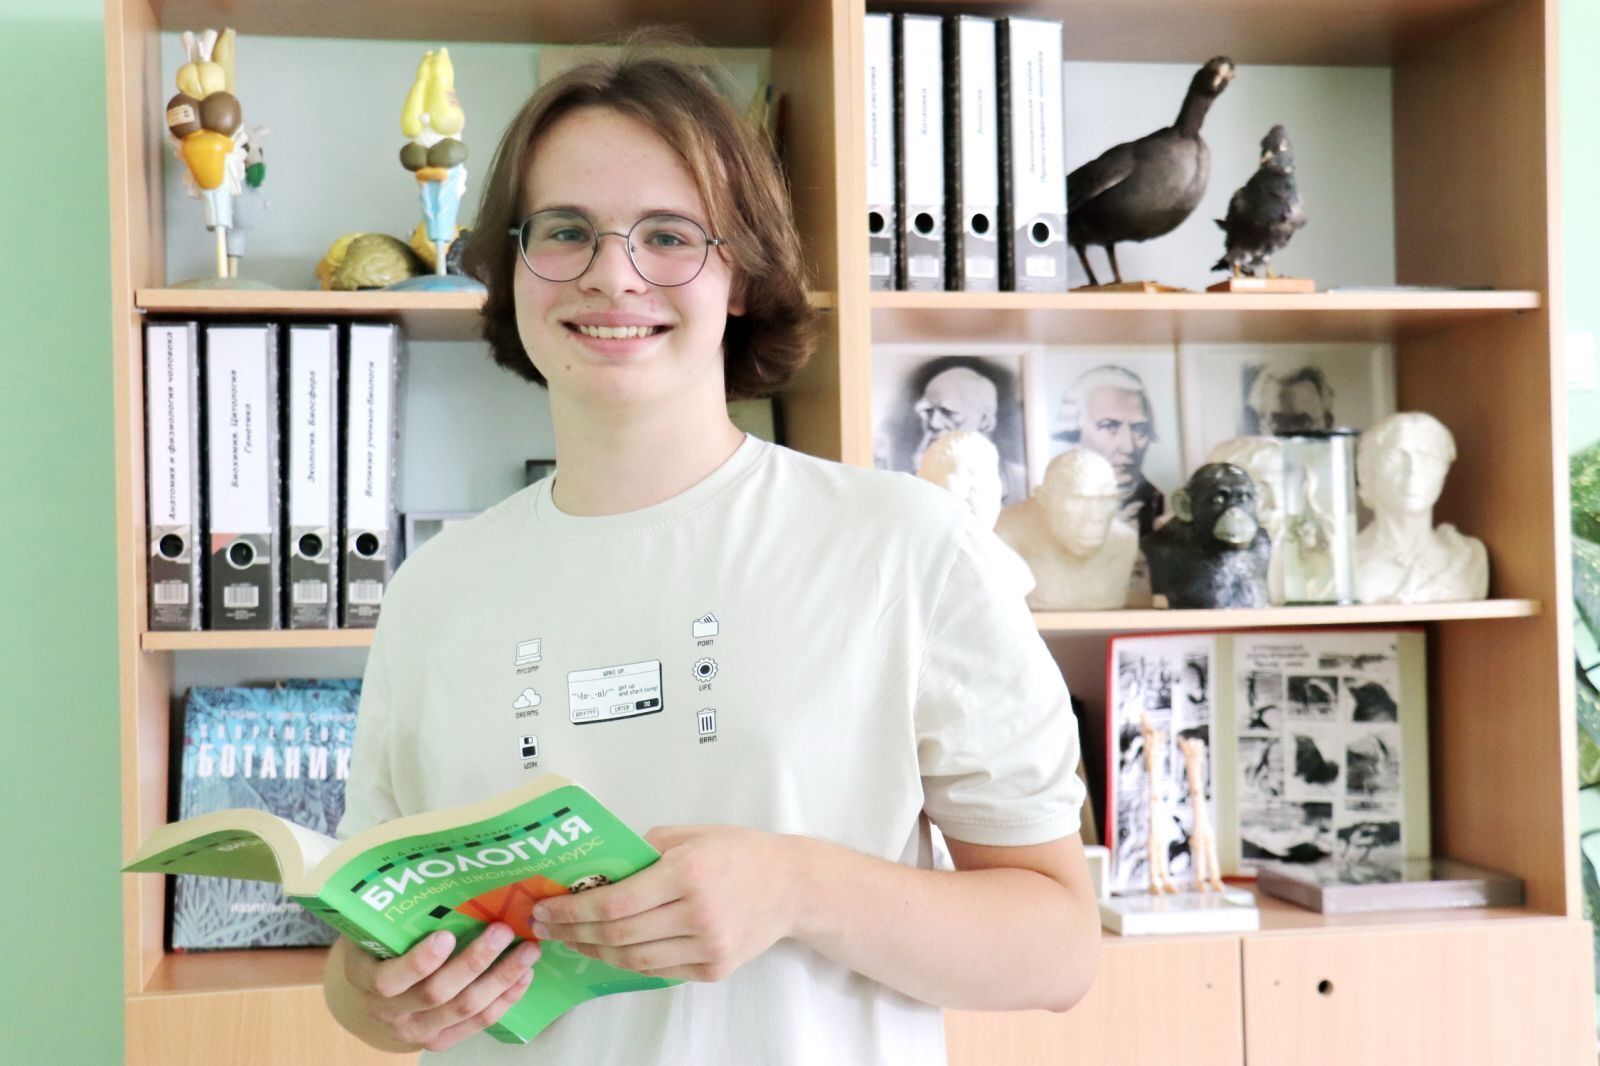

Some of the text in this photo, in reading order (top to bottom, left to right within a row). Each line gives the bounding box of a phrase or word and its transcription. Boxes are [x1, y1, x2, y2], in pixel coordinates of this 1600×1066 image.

[166, 331, 174, 383] человека
[167, 386, 177, 456] физиология
[230, 370, 239, 427] Цитология
[308, 370, 317, 426] Биосфера
[244, 403, 252, 454] Генетика
[168, 467, 176, 520] Анатомия
[365, 451, 374, 497] Великие
[697, 639, 714, 647] PORN
[516, 665, 540, 675] MYCOMP
[602, 669, 616, 677] WAKE
[629, 687, 643, 695] start
[515, 709, 539, 719] DREAMS
[614, 704, 630, 713] LATER
[699, 735, 717, 744] BRAIN
[523, 761, 538, 770] WORK
[361, 815, 593, 912] БИОЛОГИЯ
[383, 835, 605, 923] Полный школьный курс
